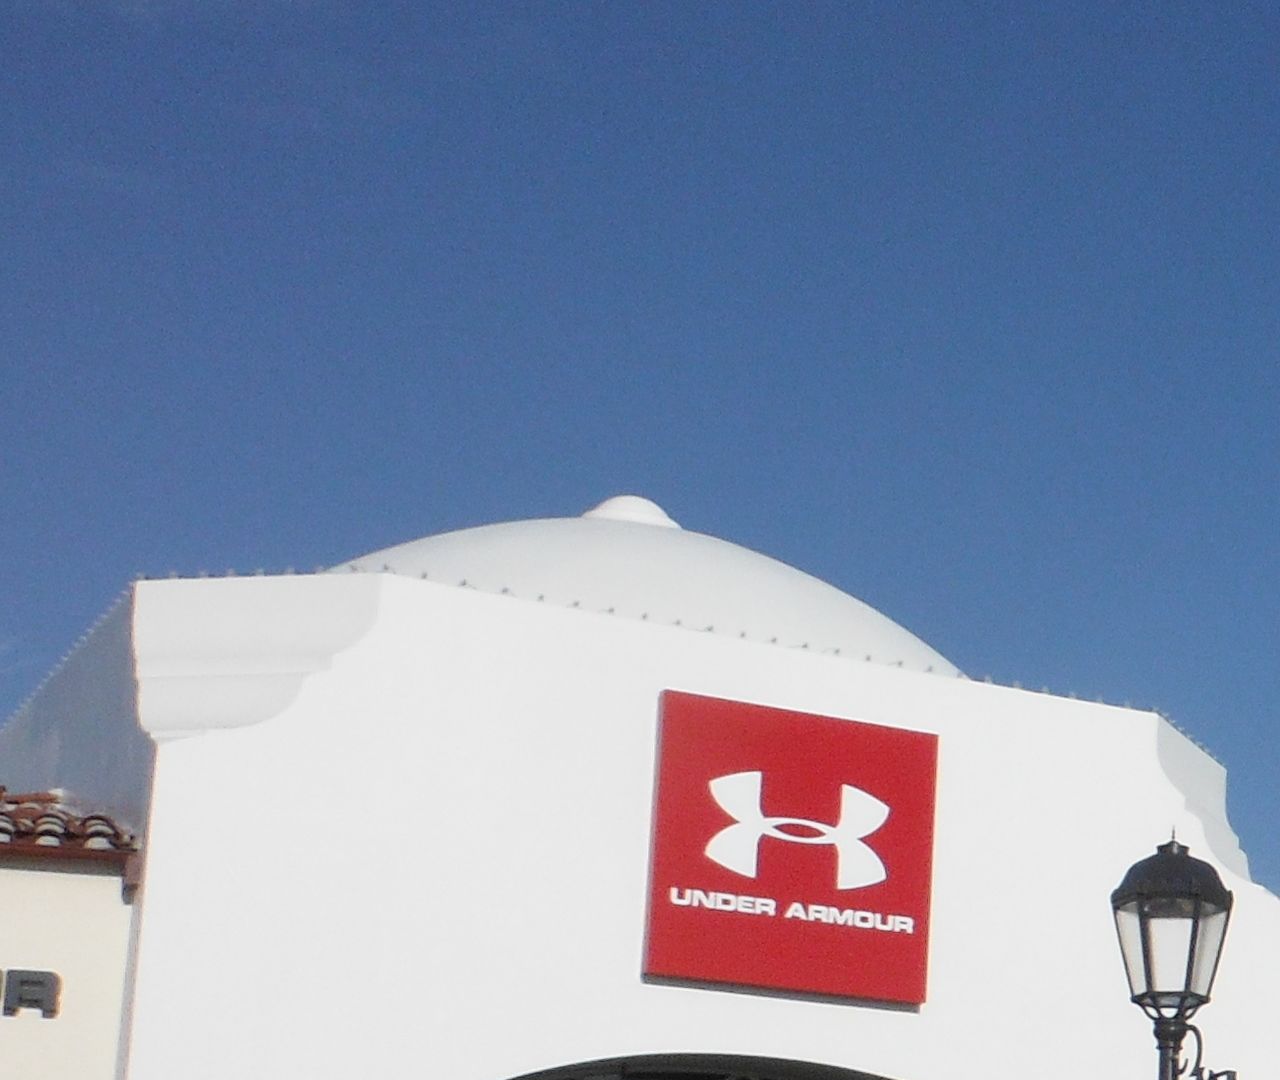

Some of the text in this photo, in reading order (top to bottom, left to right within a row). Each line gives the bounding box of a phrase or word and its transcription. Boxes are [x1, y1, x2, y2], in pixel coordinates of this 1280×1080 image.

[669, 886, 915, 935] UNDER ARMOUR
[0, 969, 61, 1018] R
